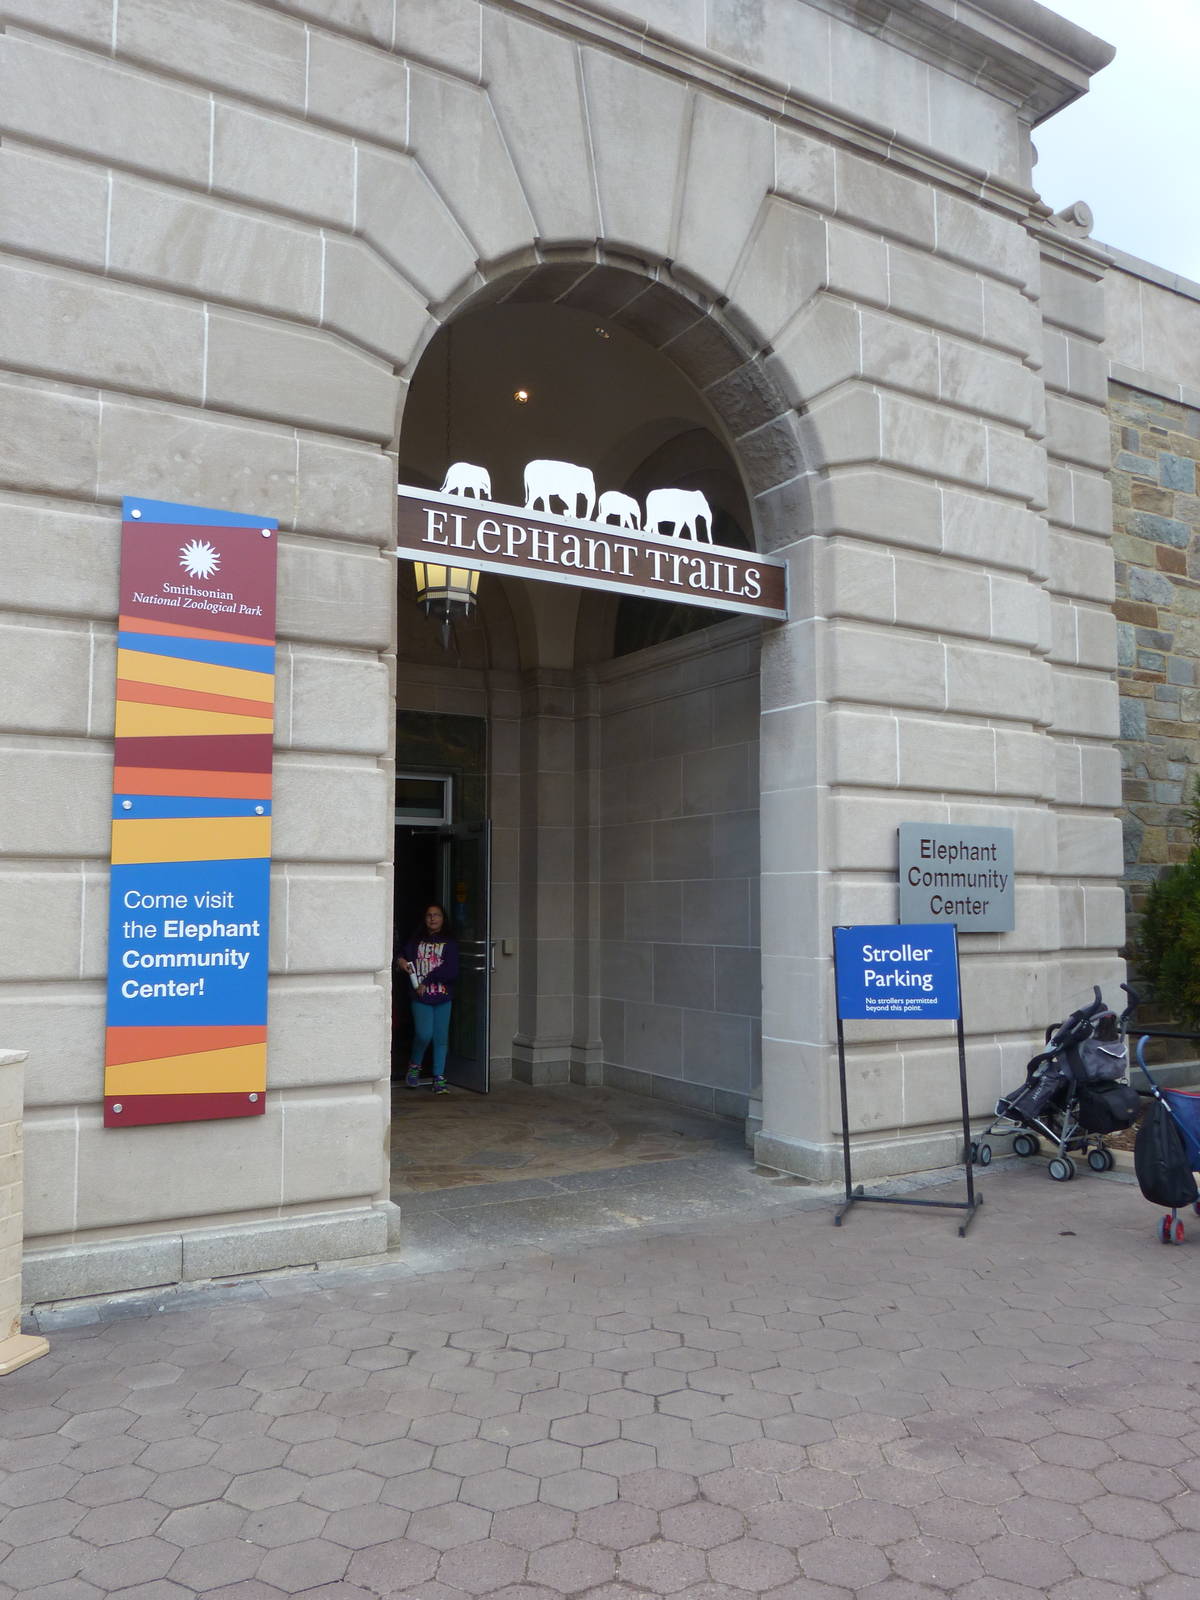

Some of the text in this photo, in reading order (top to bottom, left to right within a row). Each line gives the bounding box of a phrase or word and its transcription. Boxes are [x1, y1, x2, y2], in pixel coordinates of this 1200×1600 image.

[163, 582, 234, 600] Smithsonian
[132, 592, 263, 616] National Zoological Park
[920, 839, 997, 864] Elephant
[908, 866, 1008, 892] Community
[124, 890, 234, 909] Come visit
[930, 895, 989, 915] Center
[123, 920, 260, 941] the Elephant
[122, 948, 250, 969] Community
[862, 944, 933, 962] Stroller
[121, 978, 205, 999] Center!
[864, 969, 934, 991] Parking
[865, 1004, 889, 1012] beyond
[904, 1004, 923, 1012] point.
[905, 997, 938, 1005] permitted
